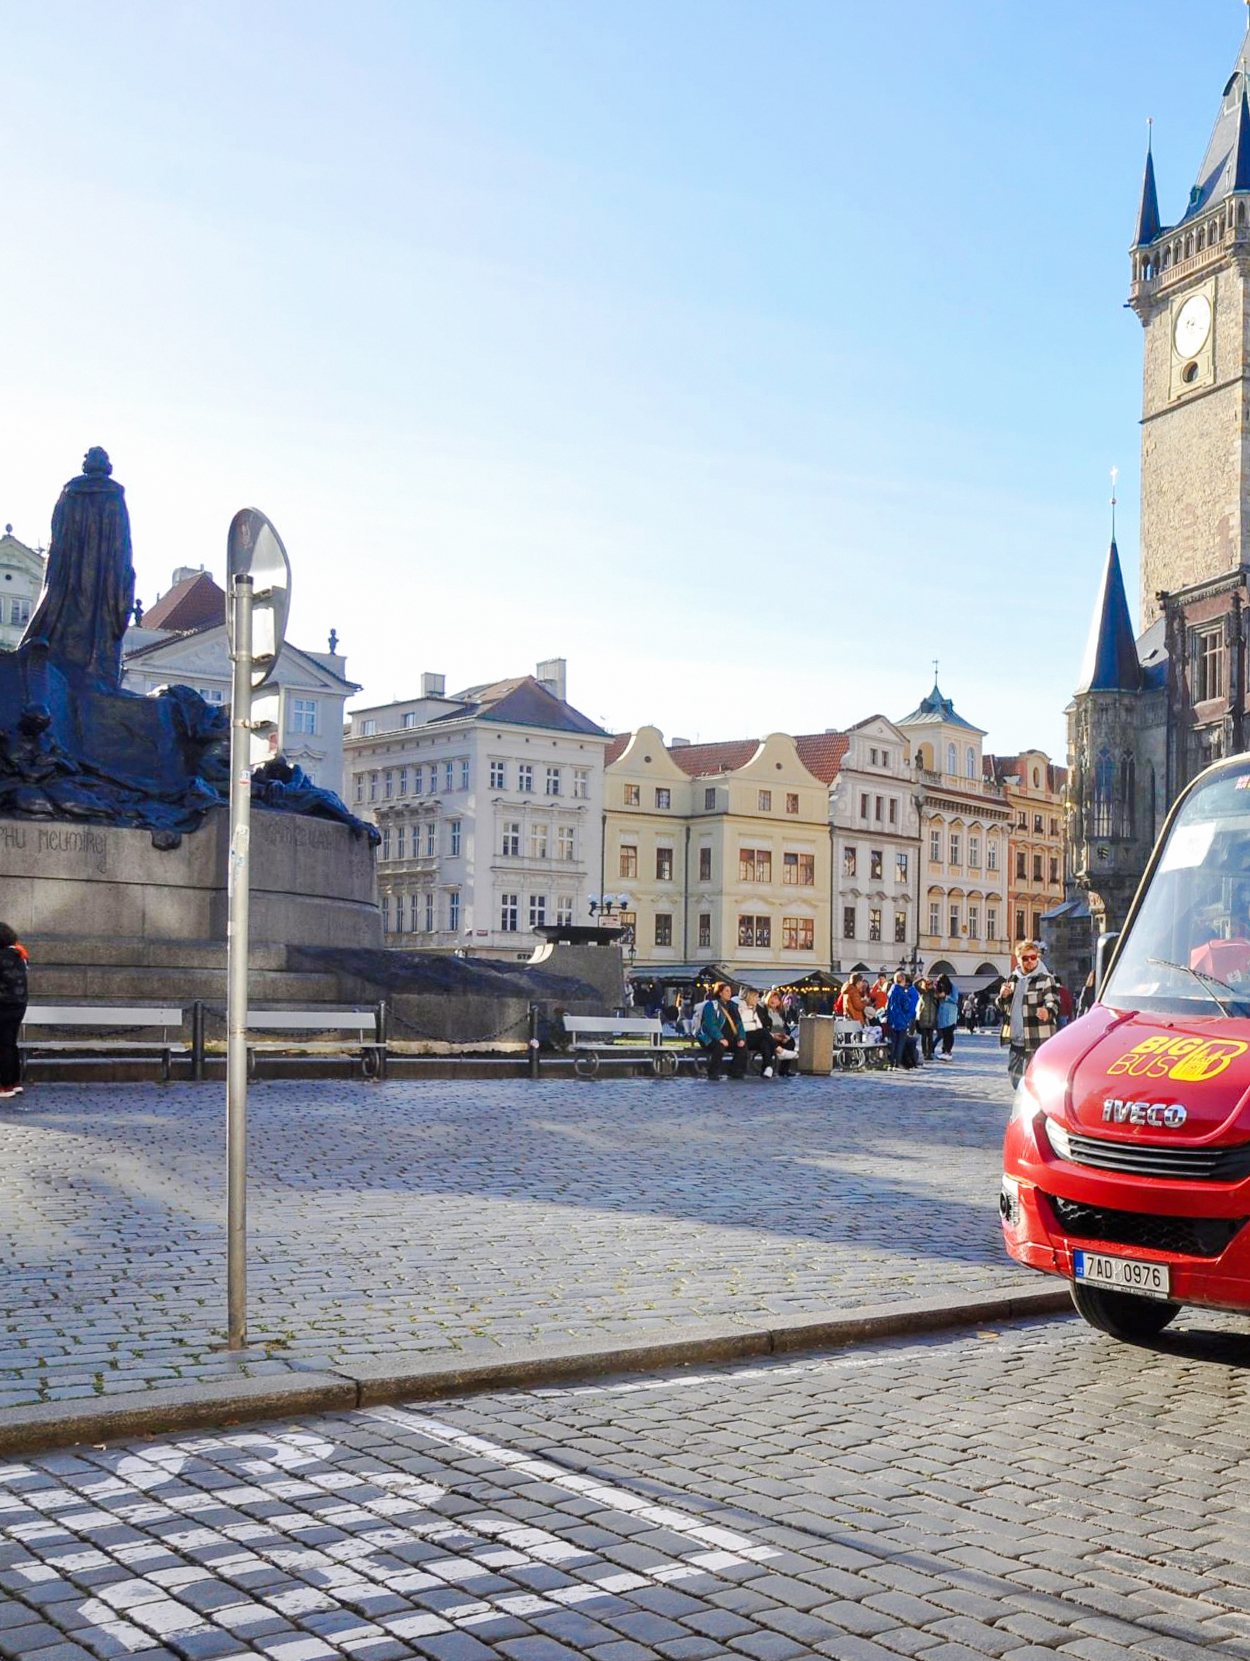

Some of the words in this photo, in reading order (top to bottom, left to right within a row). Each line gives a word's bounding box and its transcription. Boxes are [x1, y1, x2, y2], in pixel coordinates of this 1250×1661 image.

[739, 926, 769, 938] CAFE
[1130, 1036, 1205, 1056] BIG
[1106, 1053, 1178, 1078] BUS
[1102, 1098, 1188, 1128] IVECO
[1087, 1257, 1113, 1279] 7AD
[1123, 1263, 1161, 1287] 0976
